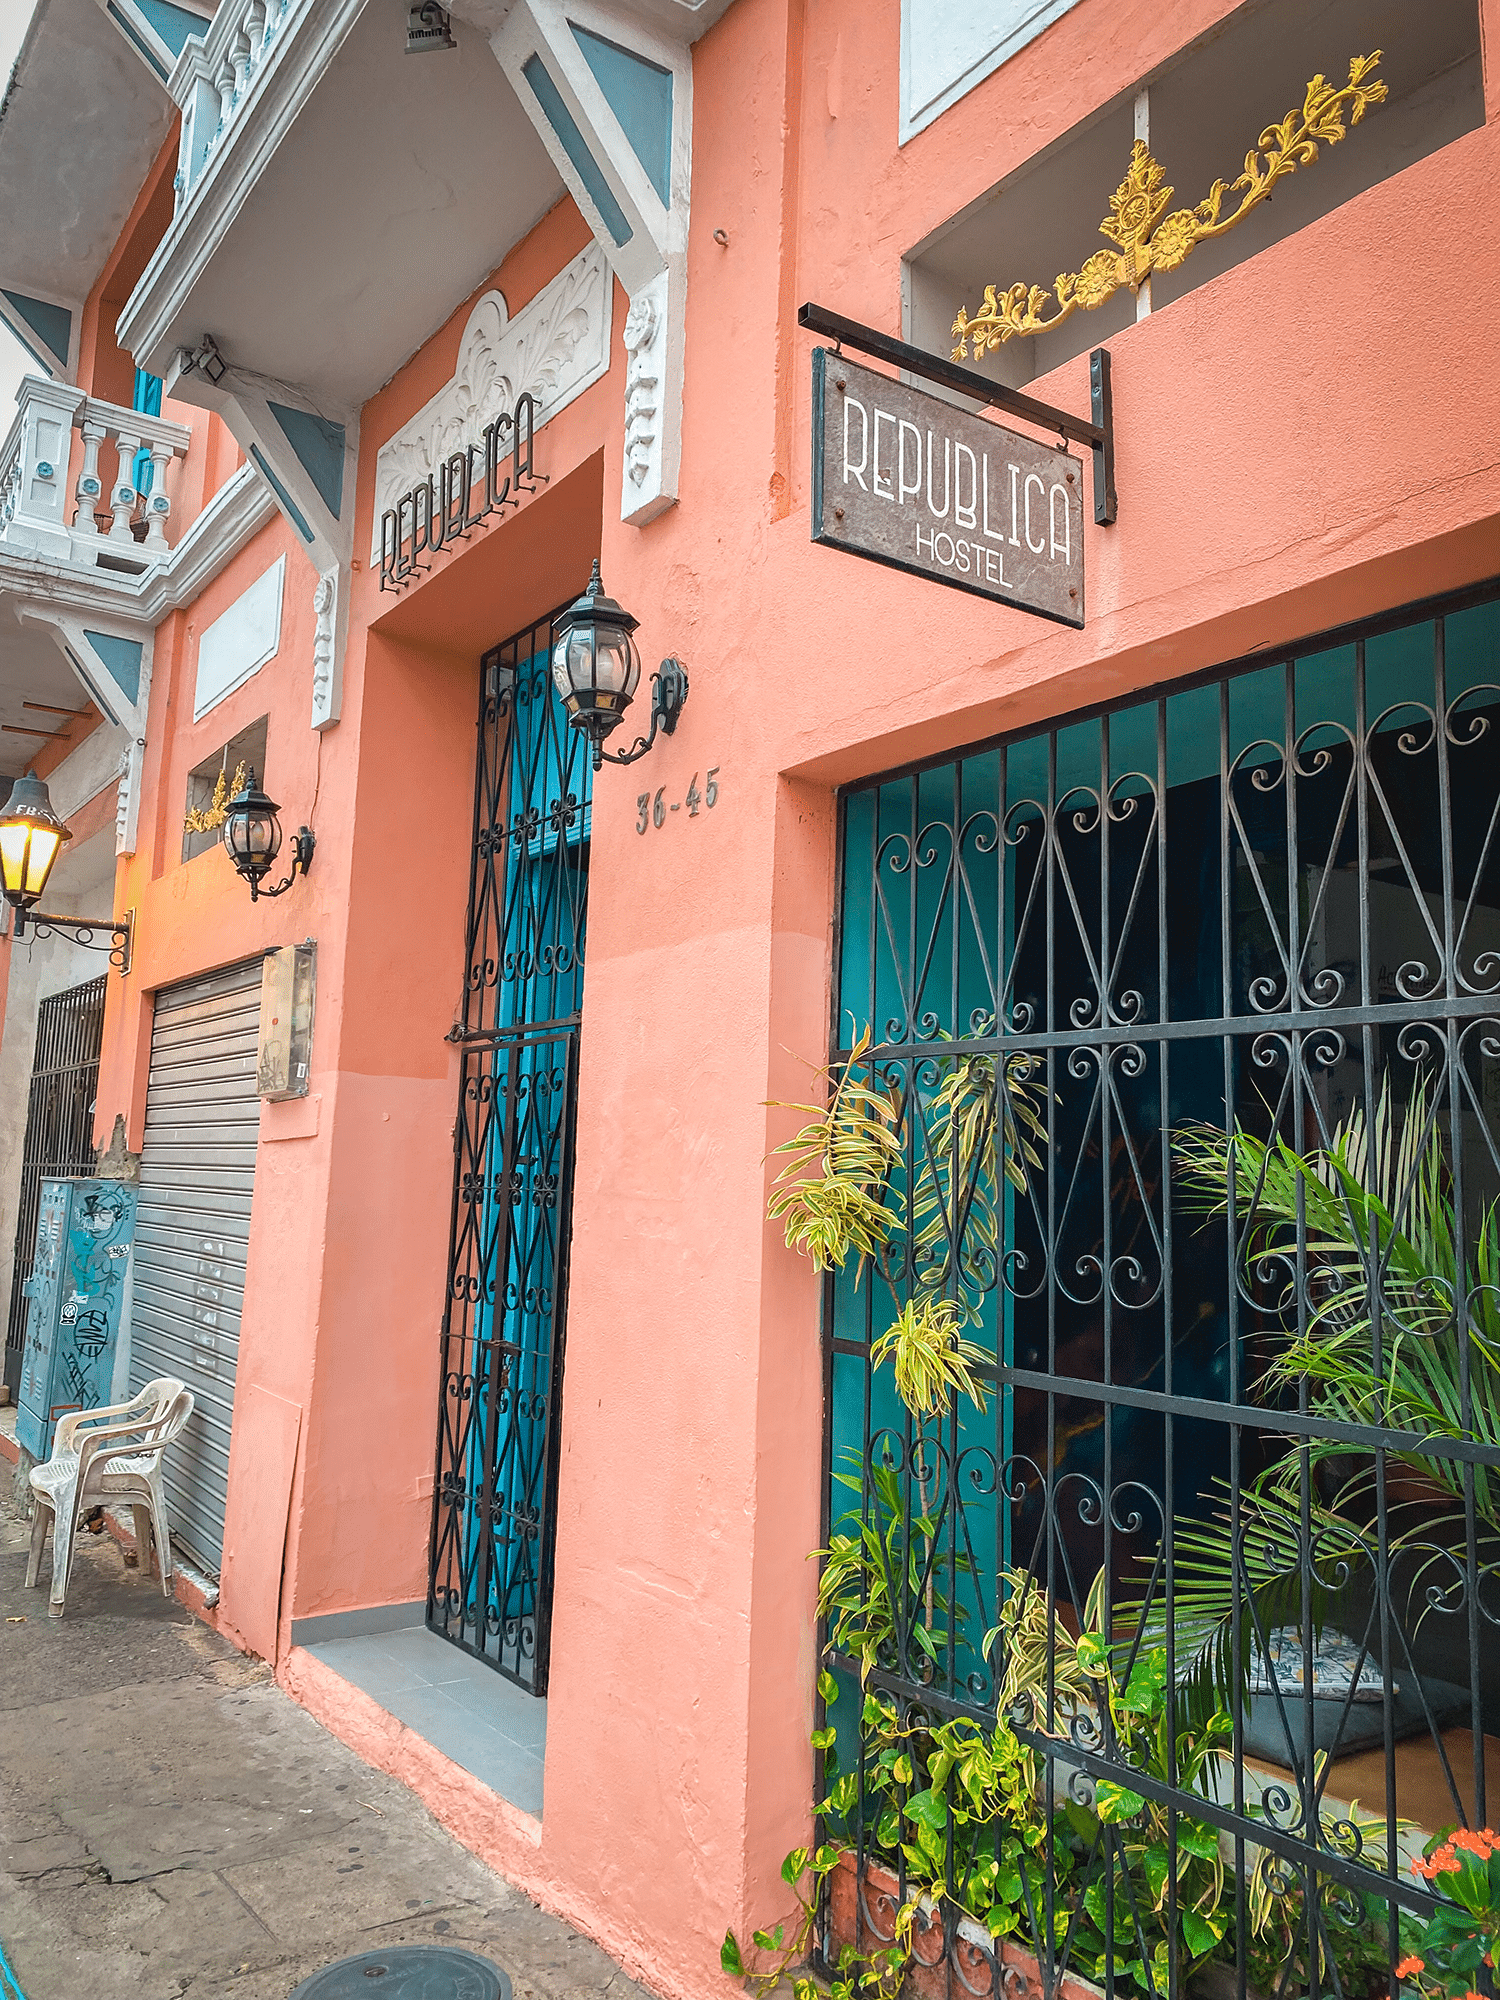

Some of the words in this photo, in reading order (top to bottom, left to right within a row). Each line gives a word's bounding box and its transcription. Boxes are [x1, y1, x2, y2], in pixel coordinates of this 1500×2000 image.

[379, 391, 534, 592] REPUBLICA
[842, 395, 1071, 566] REPUBLICA
[916, 522, 1014, 588] HOSTEL
[636, 766, 720, 836] 36-45
